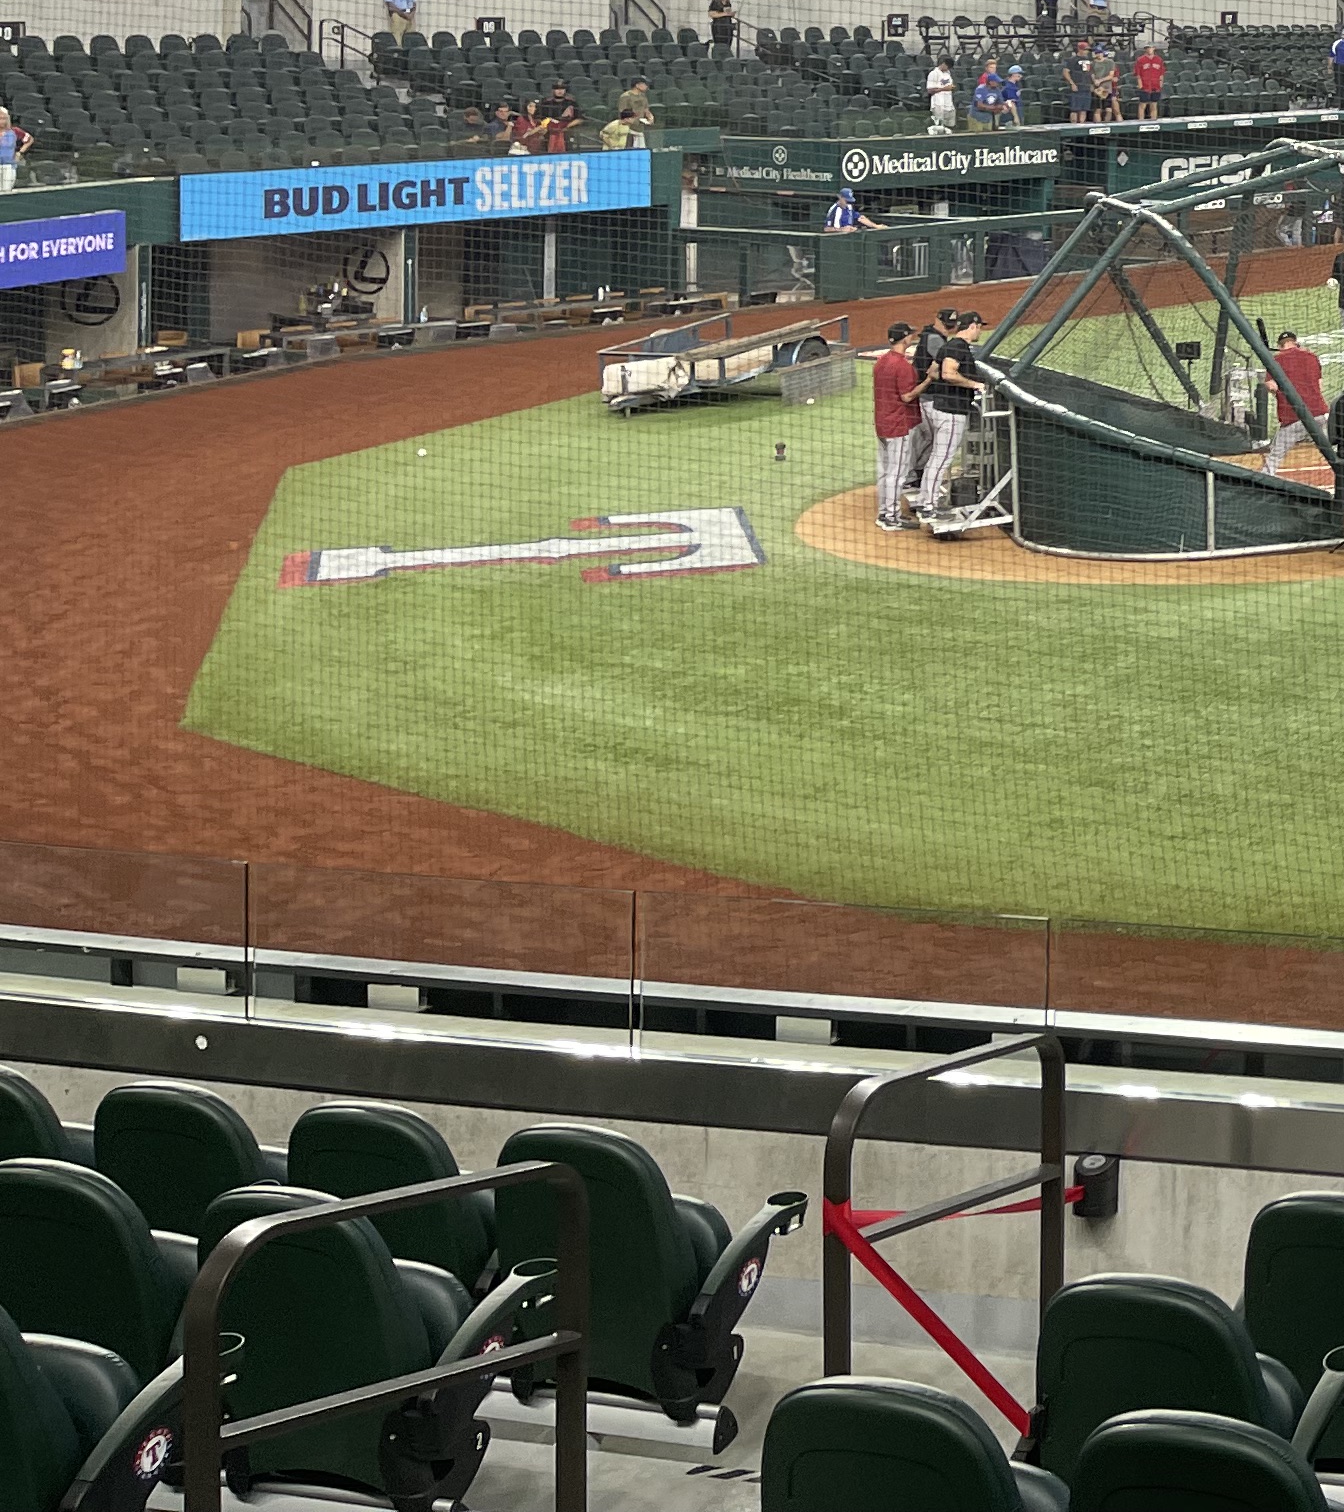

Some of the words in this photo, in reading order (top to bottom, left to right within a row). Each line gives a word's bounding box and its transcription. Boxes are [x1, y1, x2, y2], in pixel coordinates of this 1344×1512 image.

[726, 166, 762, 180] Medical
[763, 167, 781, 182] City
[872, 150, 937, 177] Medical
[938, 149, 971, 176] City
[973, 144, 1057, 170] Healthcare
[264, 185, 349, 219] BUD
[357, 176, 469, 213] LIGHT
[475, 160, 588, 212] SELTZER
[9, 242, 39, 263] FOR
[42, 232, 114, 258] EVERYONE
